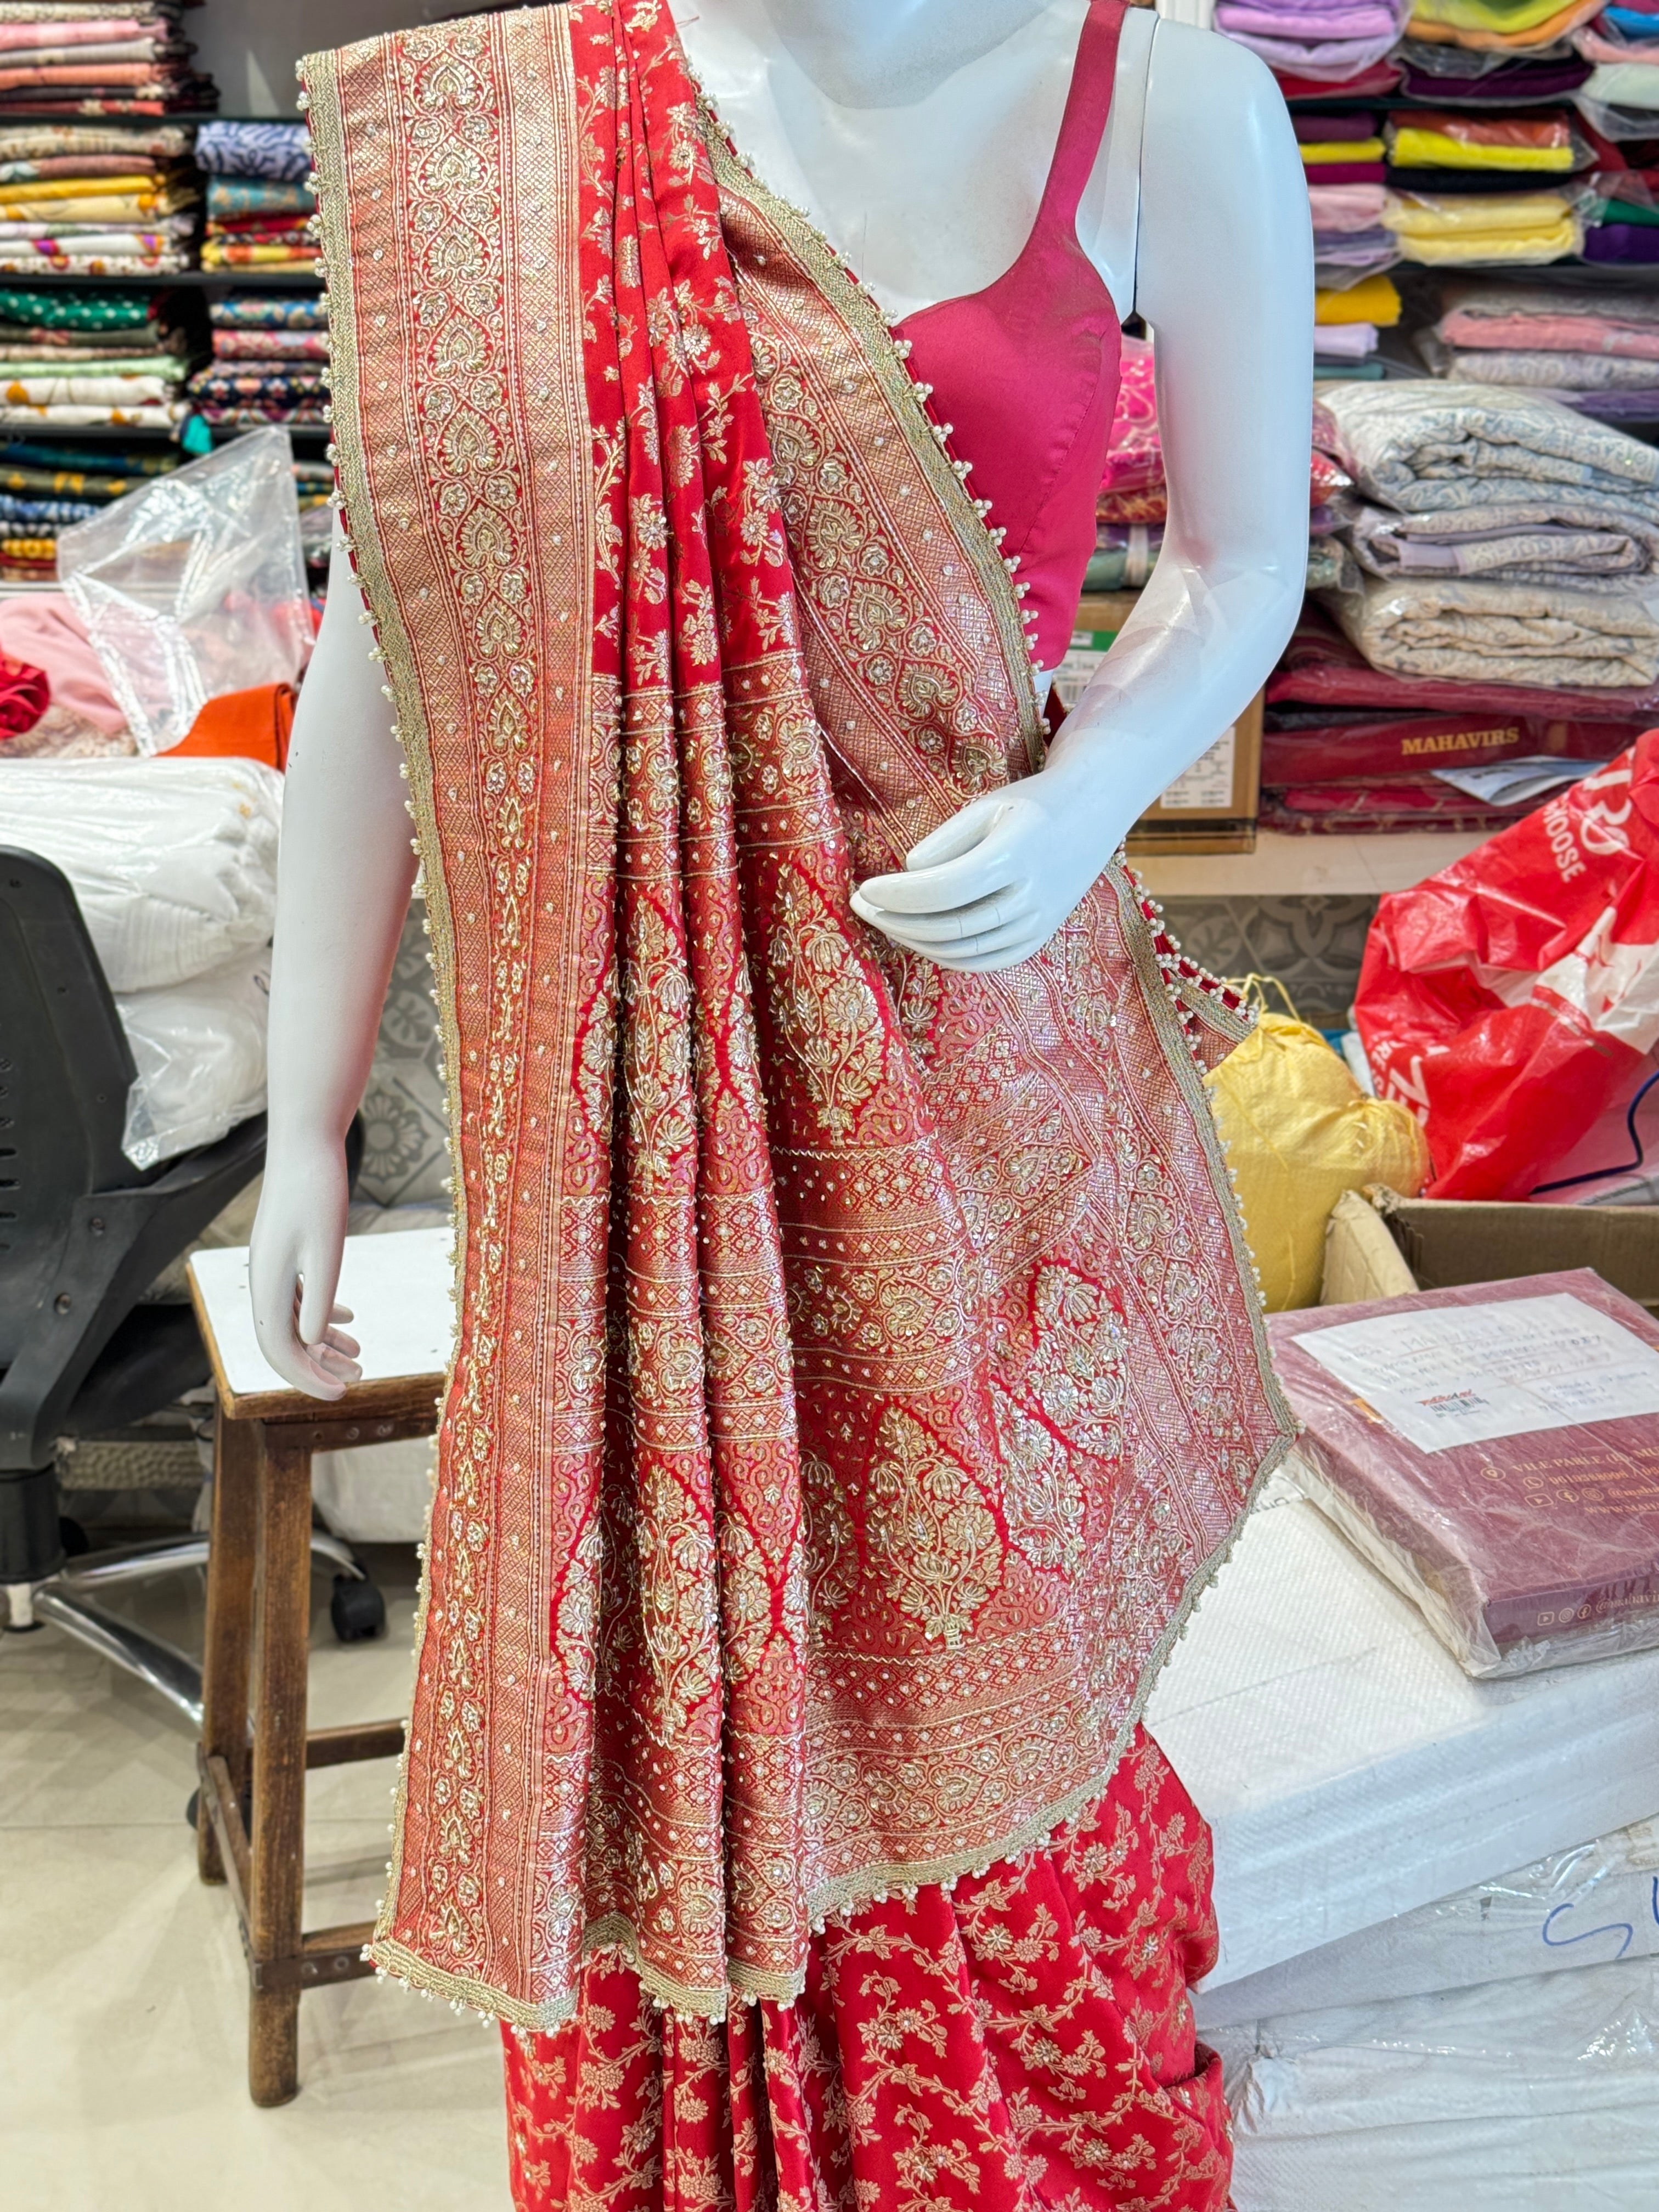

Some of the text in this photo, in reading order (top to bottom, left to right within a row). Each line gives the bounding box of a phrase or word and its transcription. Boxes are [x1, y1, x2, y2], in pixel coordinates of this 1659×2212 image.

[1402, 727, 1520, 755] MAHAVIRS
[1543, 800, 1586, 883] MOOSE
[1513, 1460, 1552, 1473] VILE
[1553, 1455, 1605, 1468] PARLE
